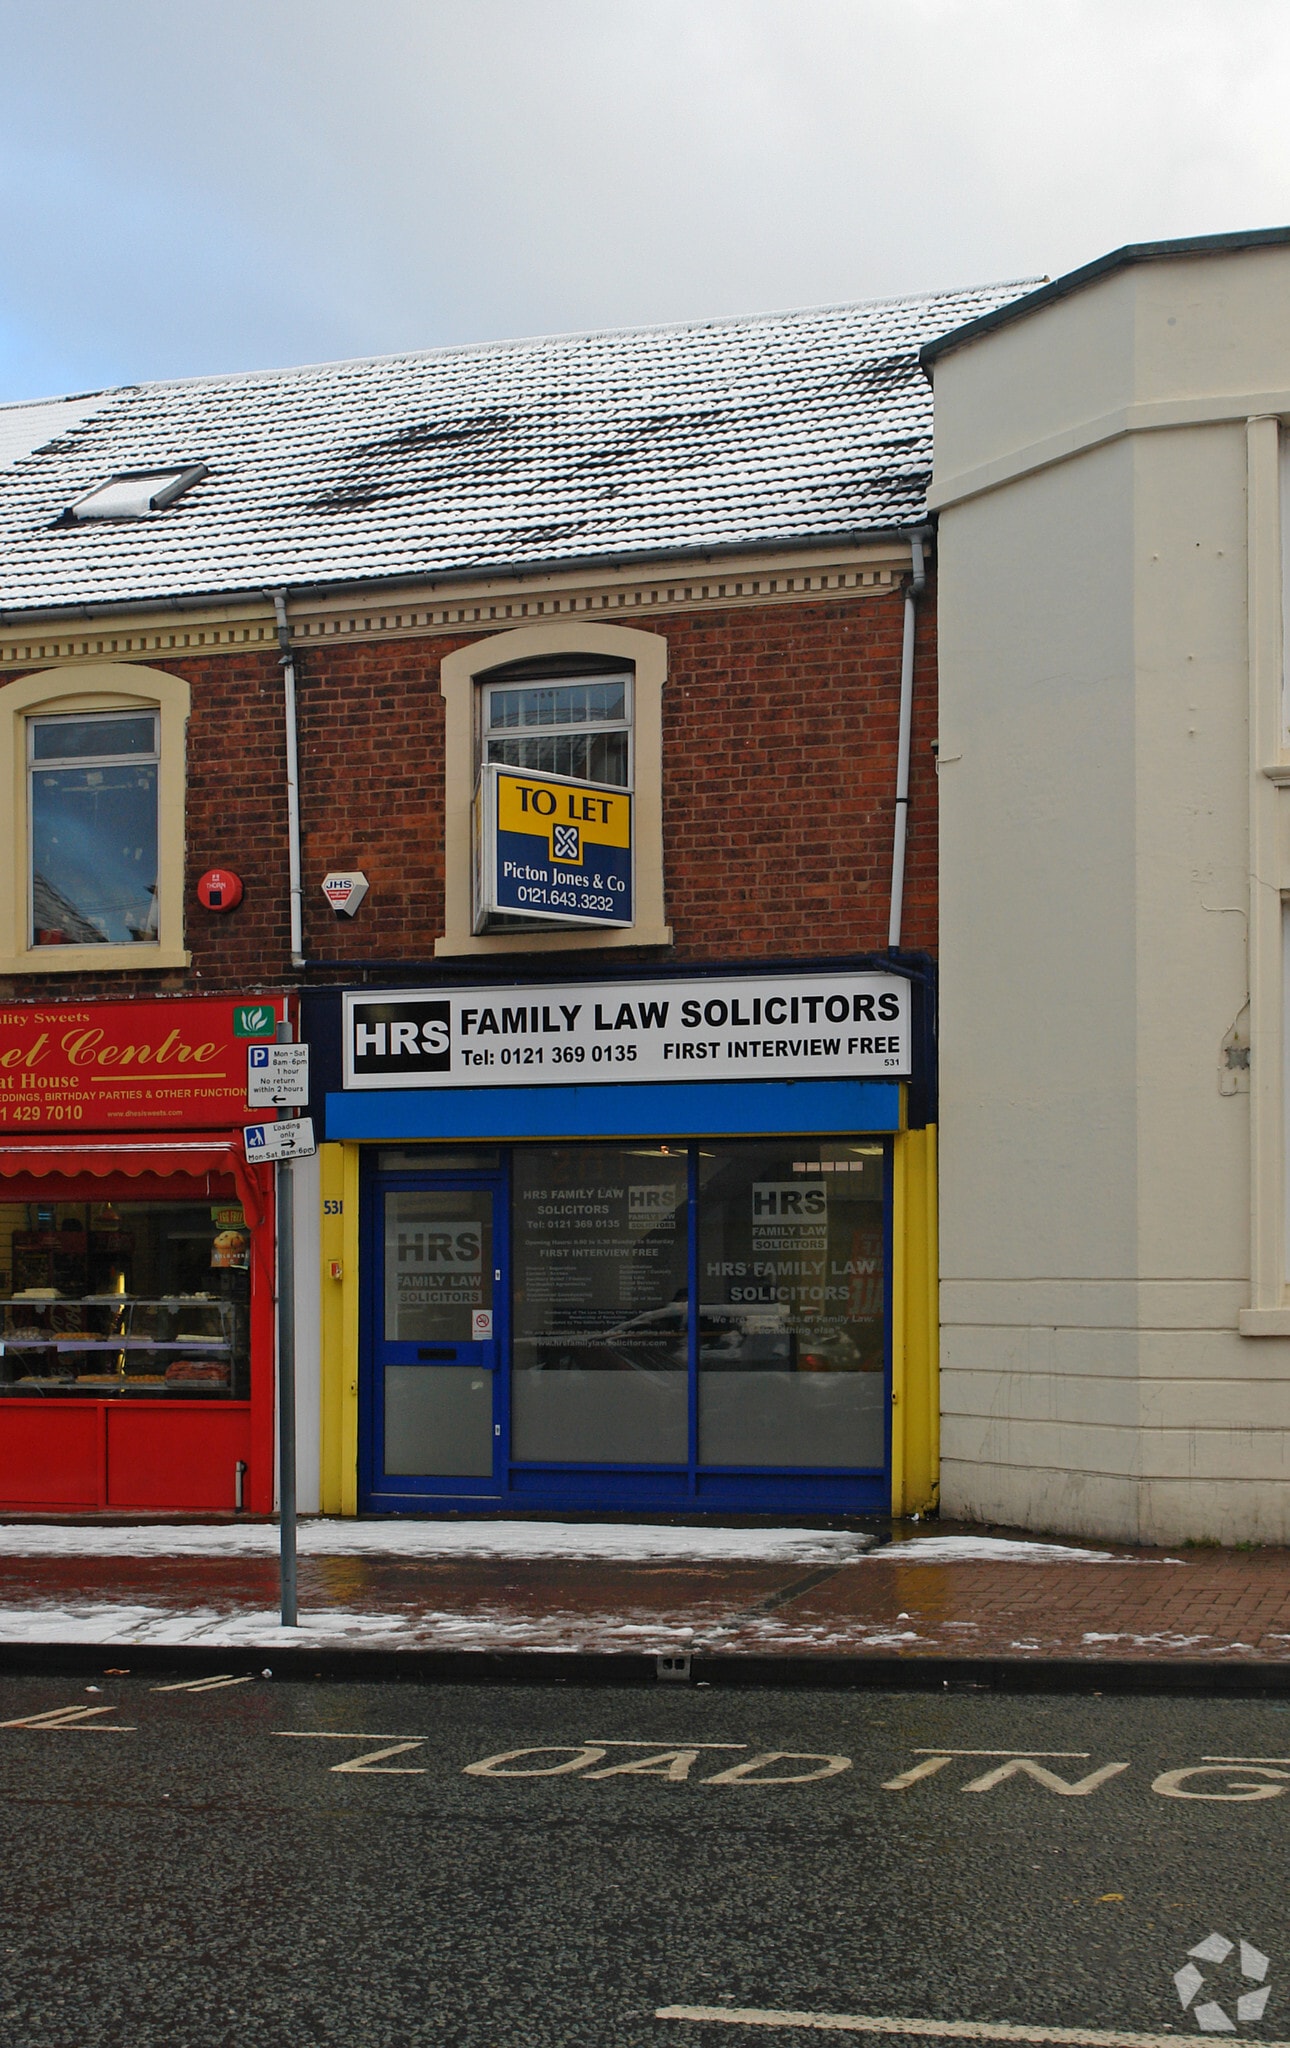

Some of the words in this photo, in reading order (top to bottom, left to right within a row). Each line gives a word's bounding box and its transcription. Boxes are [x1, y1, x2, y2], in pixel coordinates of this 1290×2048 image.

[516, 786, 557, 816] TO
[569, 795, 613, 824] LET
[503, 861, 548, 882] Picton
[552, 868, 589, 887] Jones
[593, 874, 603, 890] &
[607, 875, 625, 892] Co
[325, 880, 352, 889] JHS
[517, 886, 614, 912] 0121.643.3232
[0, 1013, 29, 1026] lity
[34, 1012, 90, 1024] Sweets
[355, 1019, 450, 1057] HRS
[461, 1004, 583, 1036] FAMILY
[594, 1002, 670, 1031] LAW
[681, 993, 900, 1029] SOLICITORS
[61, 1028, 228, 1066] Centre
[461, 1048, 495, 1066] Tel:
[501, 1047, 544, 1065] 0121
[551, 1046, 585, 1063] 369
[591, 1044, 637, 1063] 0135
[663, 1041, 721, 1059] FIRST
[727, 1038, 841, 1058] INTERVIEW
[848, 1036, 900, 1055] FREE
[254, 1049, 265, 1066] P
[884, 1059, 900, 1067] 531
[283, 1067, 299, 1075] hour
[21, 1072, 80, 1089] House
[45, 1091, 97, 1101] BIRTHDAY
[99, 1090, 143, 1100] PARTIES
[145, 1089, 153, 1099] &
[155, 1088, 192, 1099] OTHER
[284, 1085, 304, 1093] hours
[13, 1106, 41, 1121] 429
[46, 1105, 83, 1120] 7010
[273, 1121, 301, 1132] Loading
[279, 1131, 296, 1139] only
[523, 1190, 548, 1200] HRS
[551, 1189, 594, 1199] FAMILY
[597, 1189, 625, 1198] LAW
[630, 1191, 674, 1207] HRS
[323, 1200, 343, 1215] 531
[753, 1190, 826, 1215] HRS
[537, 1204, 609, 1215] SOLICITORS
[526, 1220, 546, 1229] Tel:
[547, 1220, 571, 1229] 0121
[574, 1220, 593, 1228] 369
[595, 1219, 621, 1228] 0135
[752, 1226, 796, 1236] FAMILY
[800, 1226, 827, 1235] LAW
[397, 1232, 480, 1262] HRS
[755, 1240, 825, 1249] SOLICITORS
[540, 1248, 568, 1257] FIRST
[572, 1248, 629, 1257] INTERVIEW
[632, 1248, 659, 1257] FREE
[707, 1261, 747, 1276] HRS
[754, 1261, 825, 1276] FAMILY
[831, 1260, 876, 1275] LAW
[398, 1276, 446, 1287] FAMILY
[451, 1275, 481, 1287] LAW
[401, 1291, 479, 1301] SOLICITORS
[730, 1285, 850, 1301] SOLICITORS
[816, 1315, 849, 1325] Family
